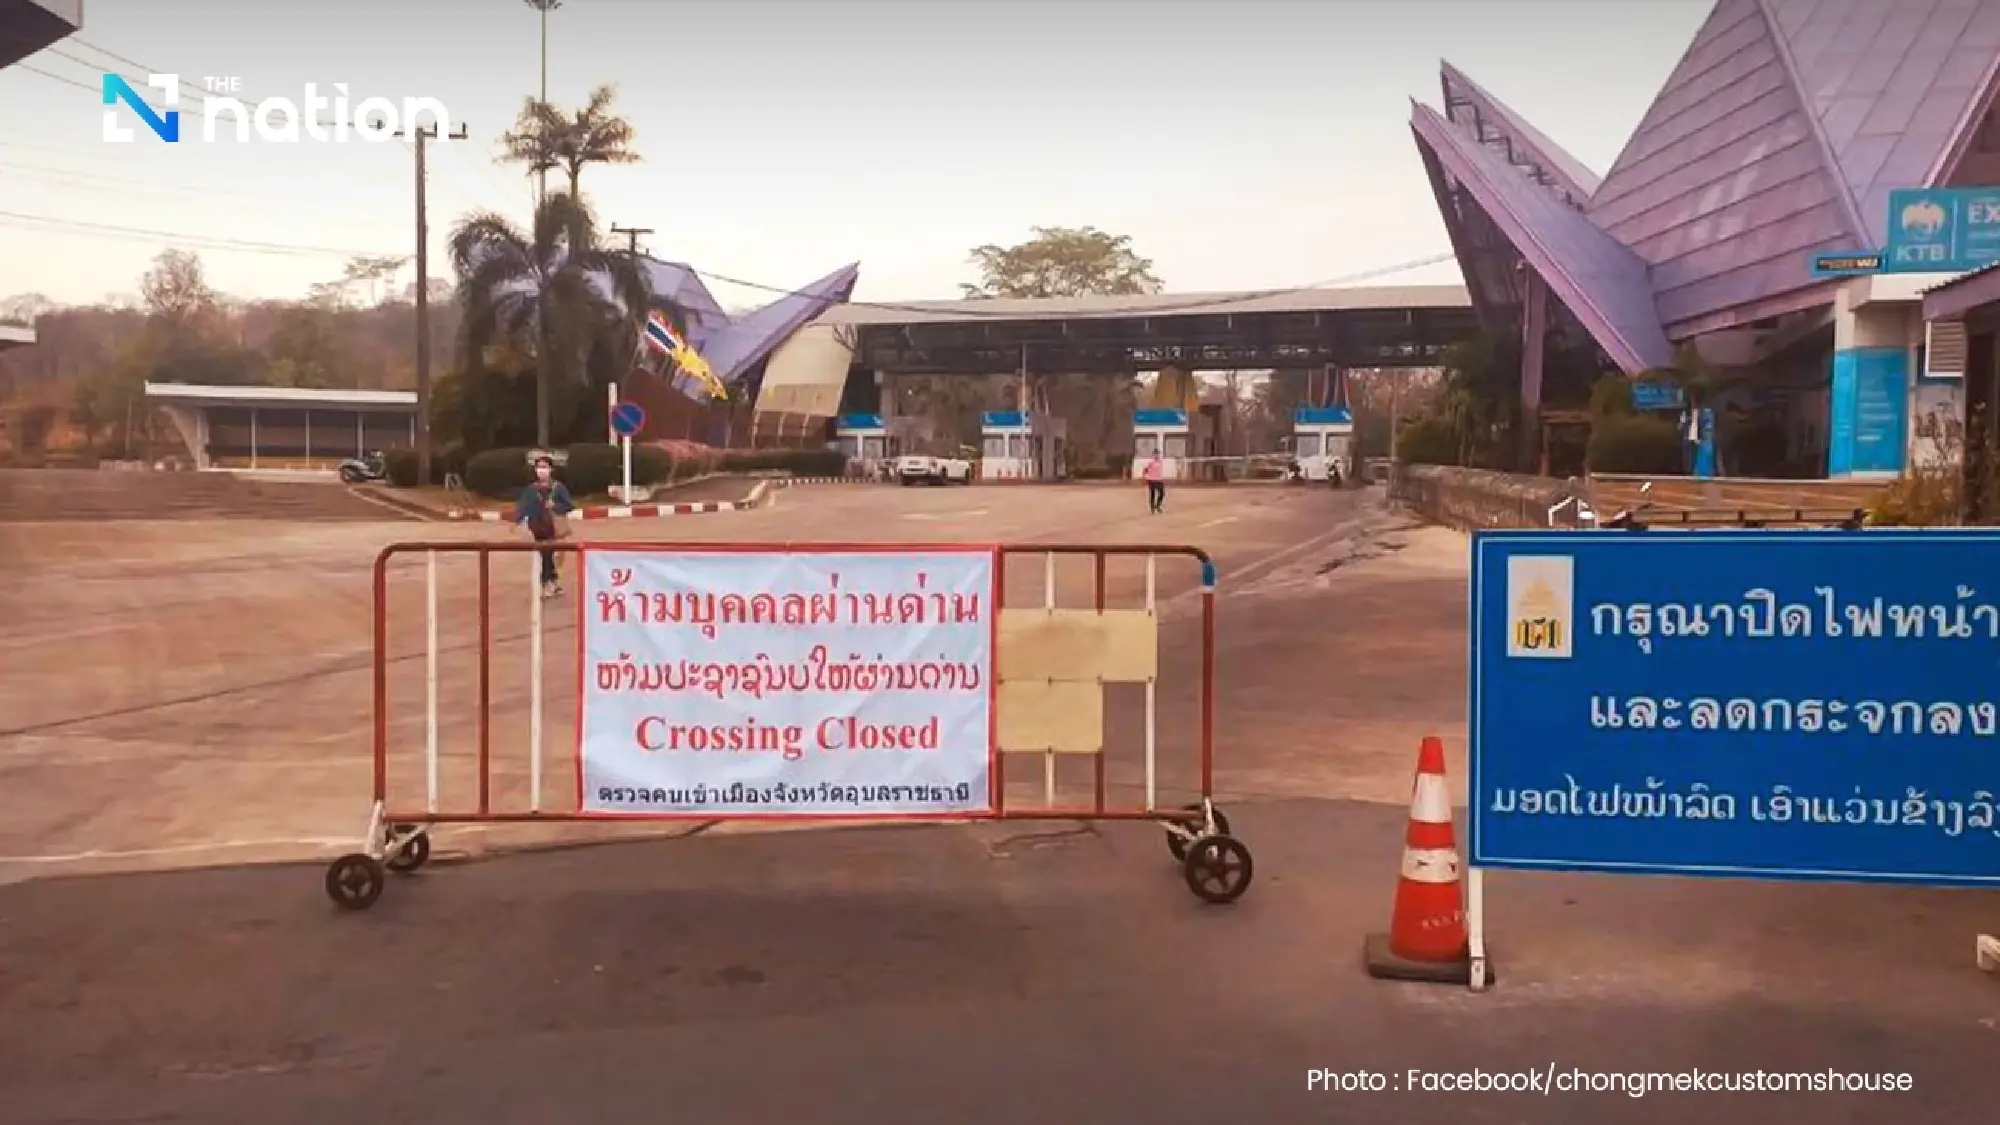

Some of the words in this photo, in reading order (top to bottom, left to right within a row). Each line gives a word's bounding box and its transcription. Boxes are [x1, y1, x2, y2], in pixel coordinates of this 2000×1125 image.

[1897, 243, 1946, 262] KTB
[597, 568, 980, 640] ห้ามบุคคลผ่านด่าน
[1591, 584, 1999, 654] กรุณาปิดไฟหน้า
[1590, 695, 1996, 735] และลดกระจกลง
[636, 716, 803, 760] Crossing
[816, 716, 940, 752] Closed
[598, 781, 970, 805] ตรวจคนเข้าเมืองจังหวัดอุบลราชธานี
